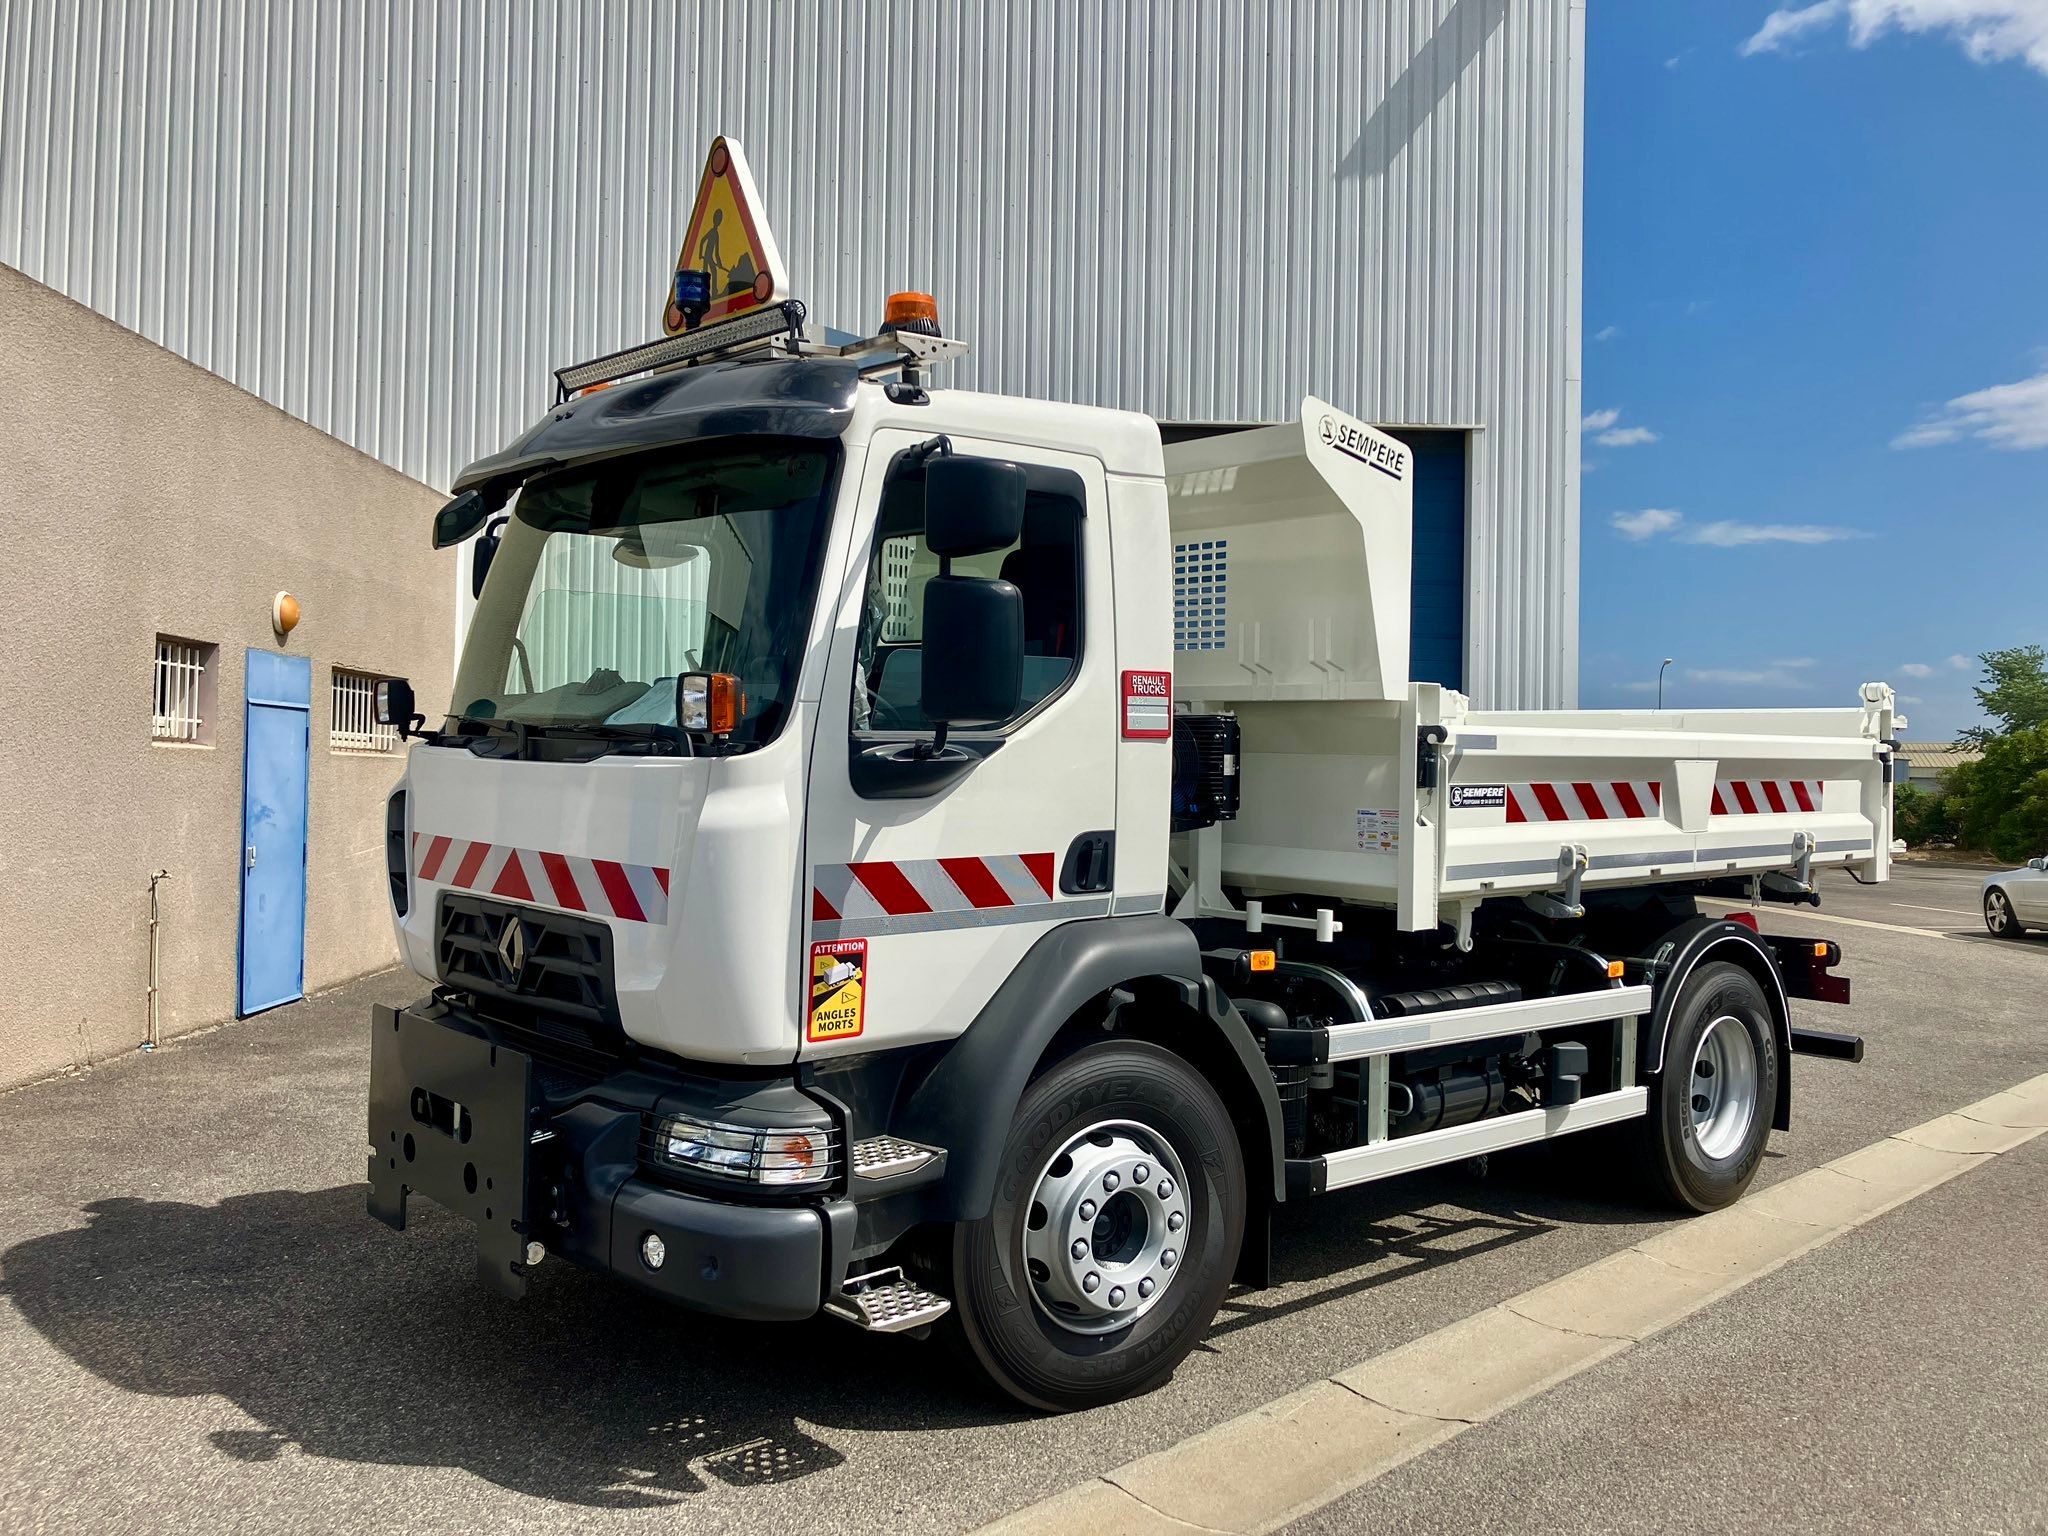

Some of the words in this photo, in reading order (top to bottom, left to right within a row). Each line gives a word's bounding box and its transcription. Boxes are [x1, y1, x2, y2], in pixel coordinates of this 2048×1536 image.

[1132, 675, 1167, 685] RENAULT
[1132, 684, 1166, 695] TRUCKS
[814, 941, 865, 954] ATTENTION
[816, 1007, 856, 1022] ANGLES
[818, 1018, 854, 1033] MORTS
